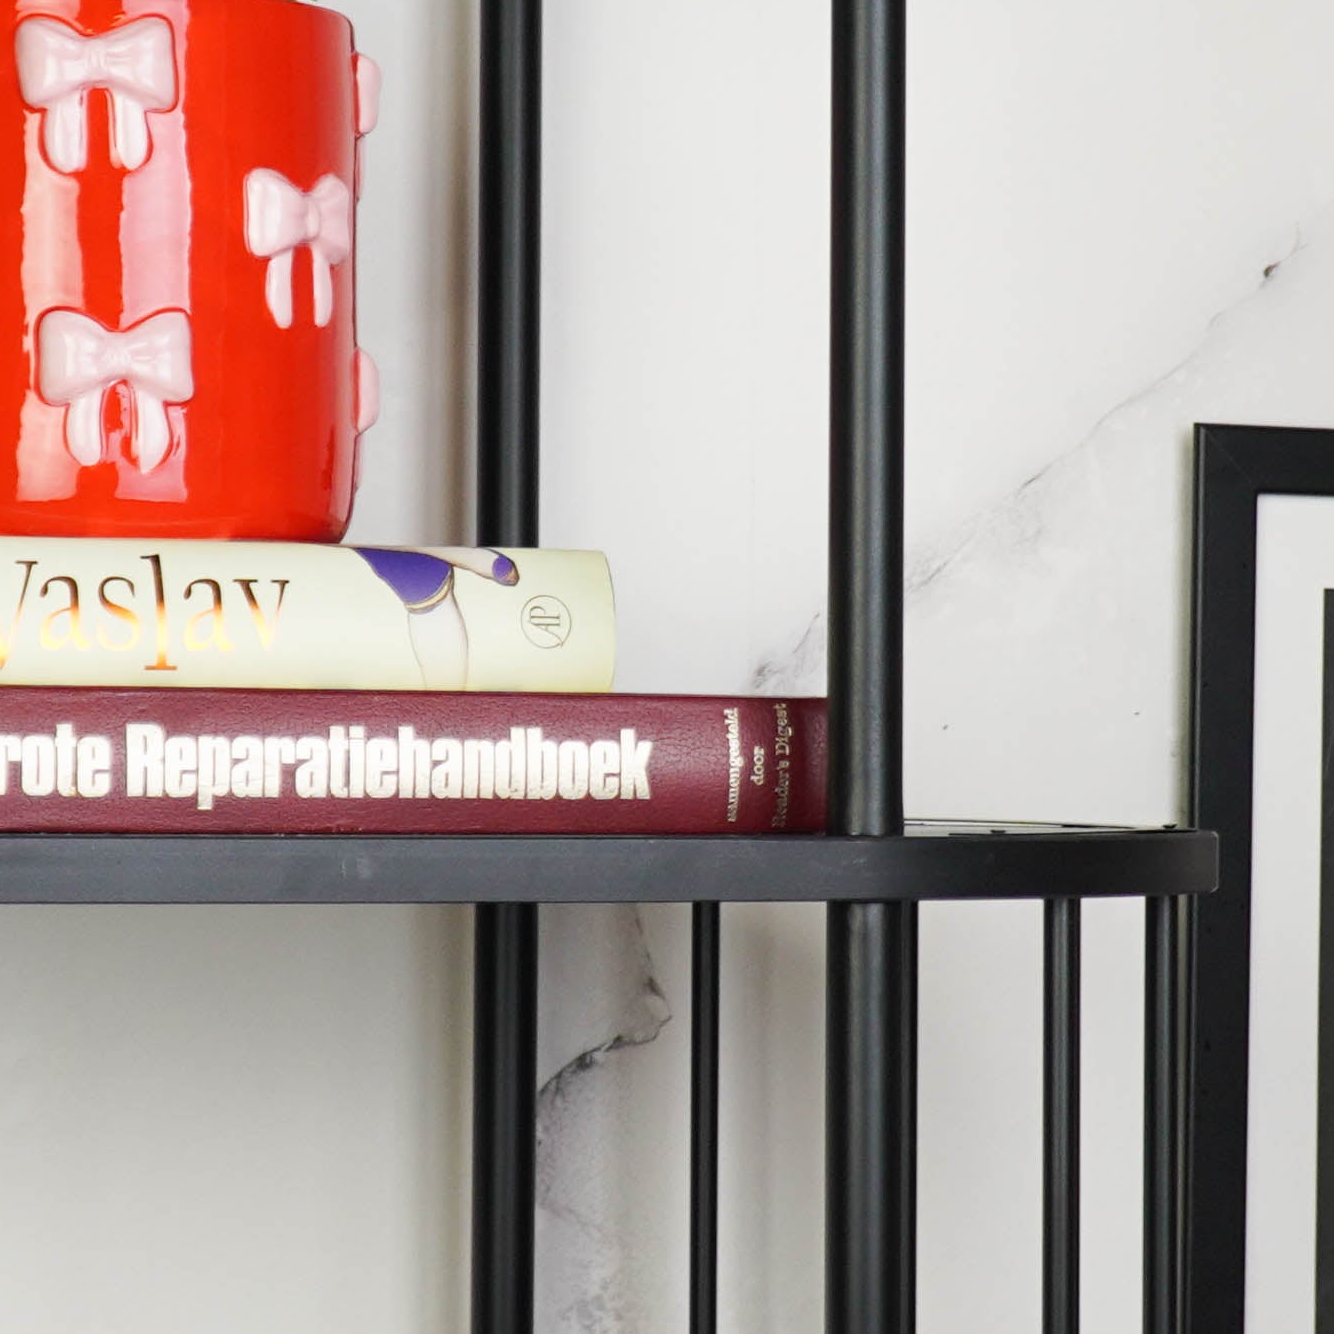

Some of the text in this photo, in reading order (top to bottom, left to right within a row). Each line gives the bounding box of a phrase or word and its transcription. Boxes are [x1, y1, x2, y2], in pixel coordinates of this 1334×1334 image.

[773, 702, 793, 756] Digest
[126, 723, 654, 811] Reparatiehandboek
[750, 745, 765, 786] door
